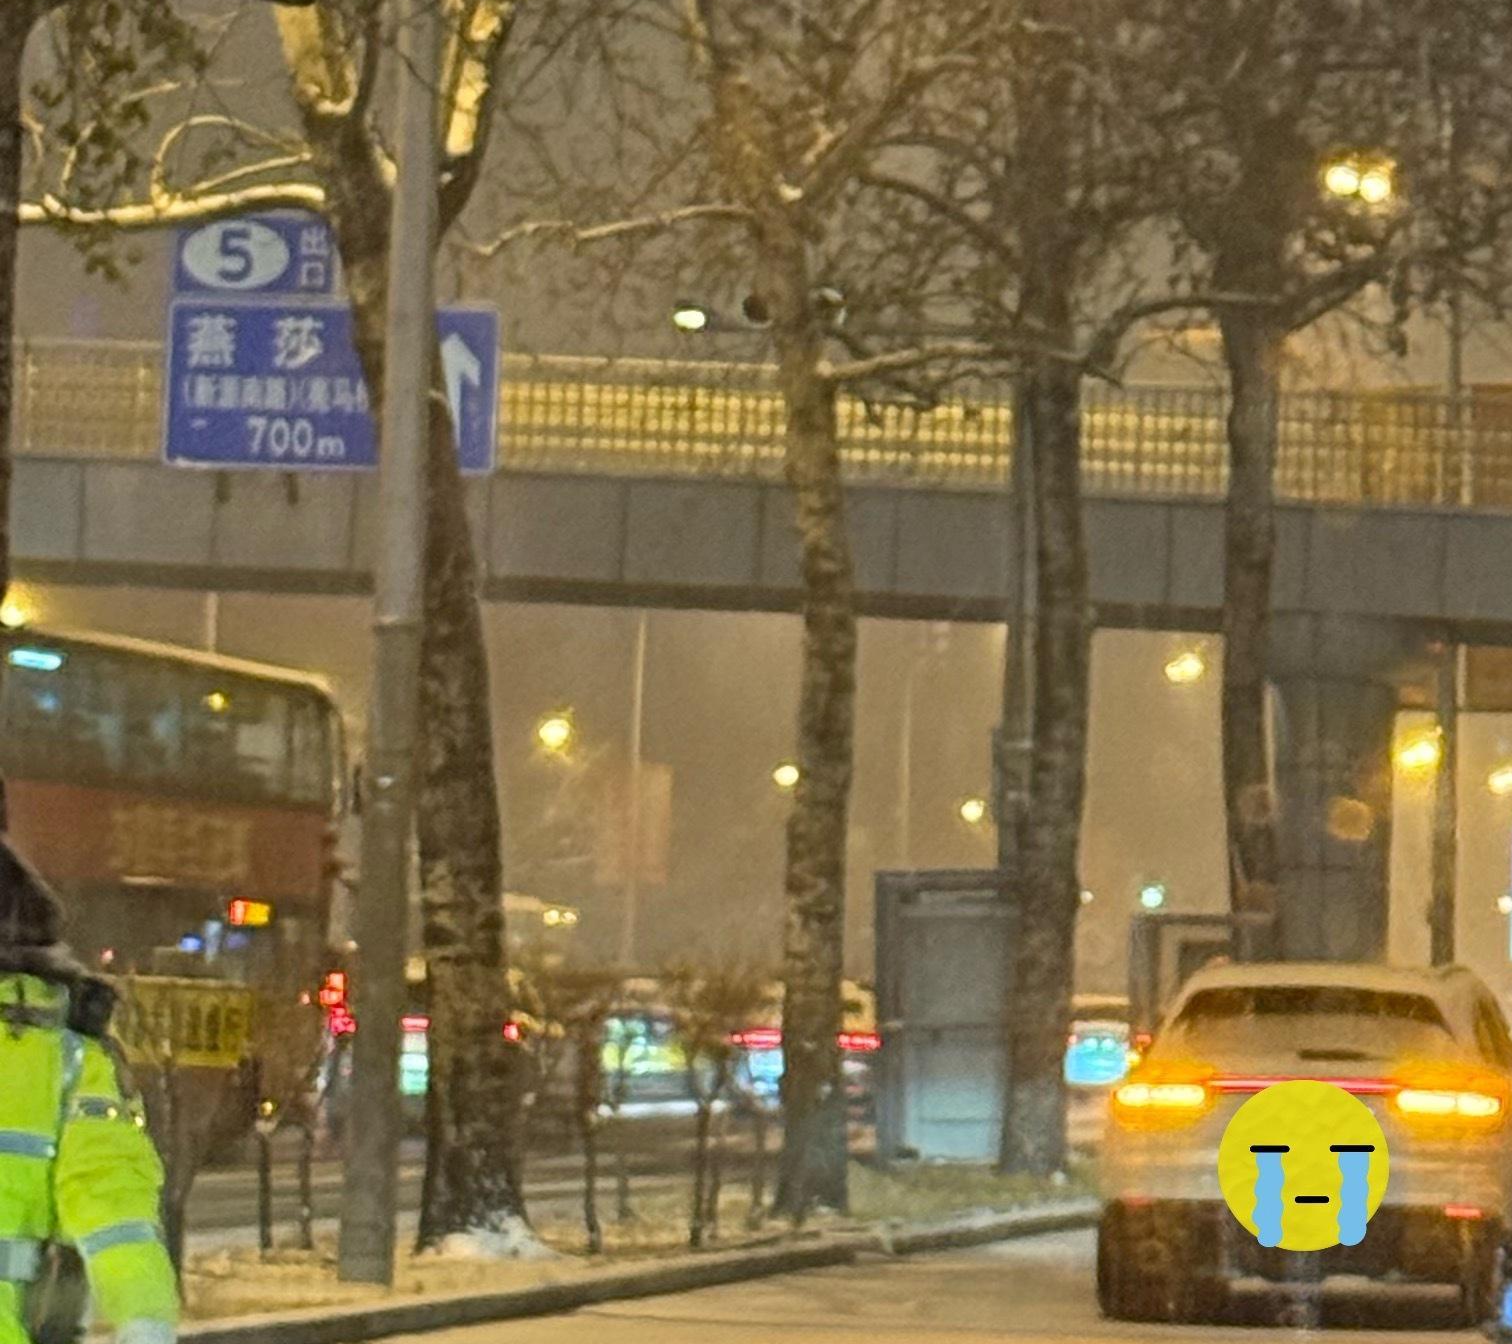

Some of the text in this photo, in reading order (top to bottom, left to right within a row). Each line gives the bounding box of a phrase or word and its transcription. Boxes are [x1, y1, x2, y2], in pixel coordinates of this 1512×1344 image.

[219, 227, 256, 283] 5
[300, 226, 330, 287] 出口
[247, 415, 346, 457] 700m
